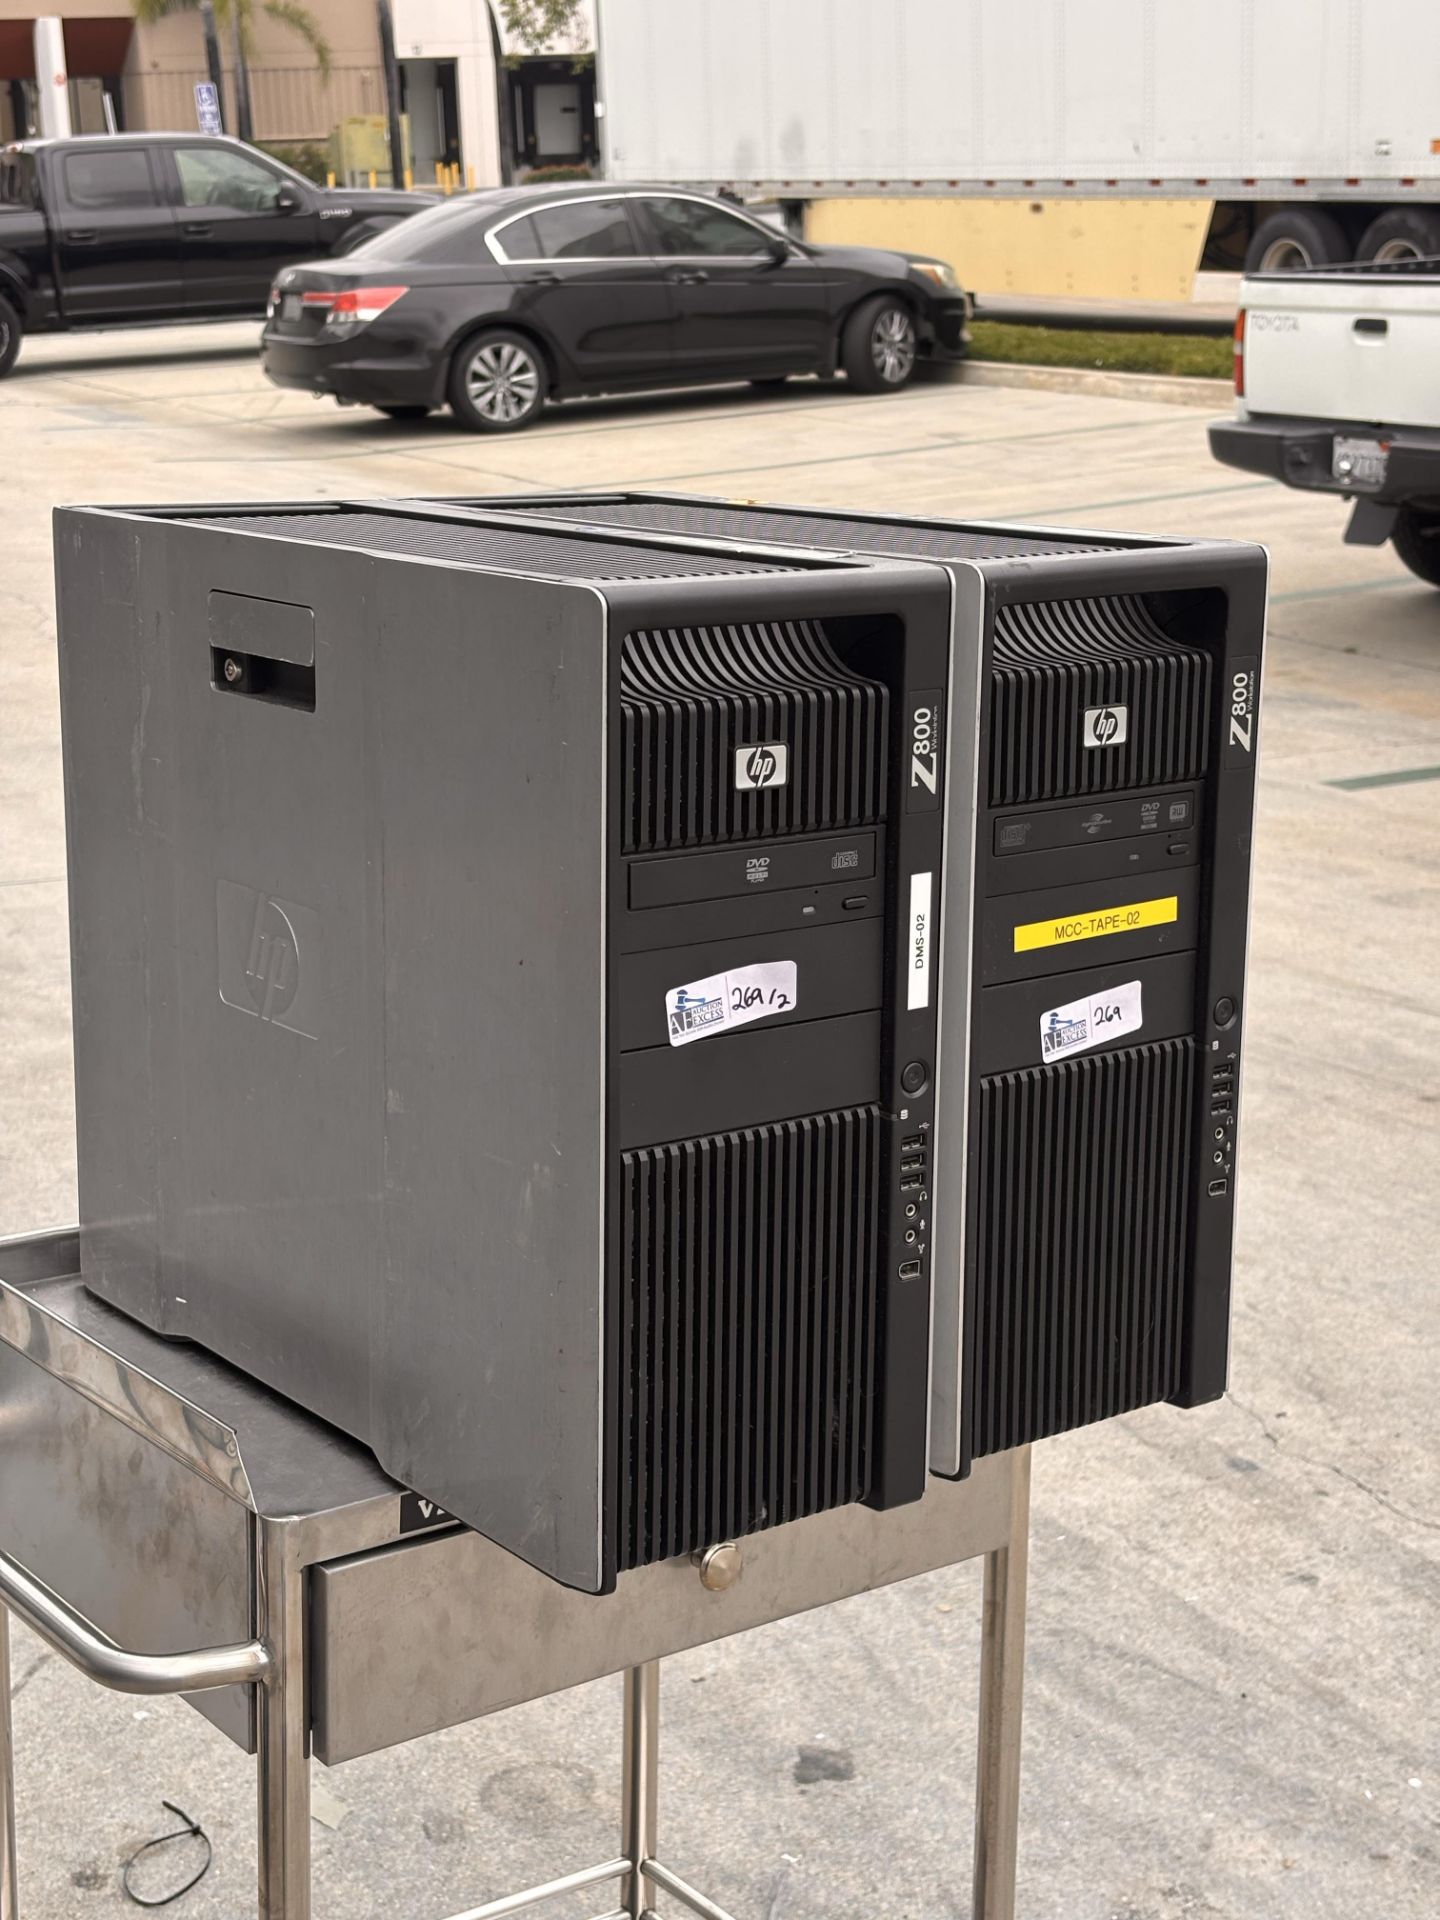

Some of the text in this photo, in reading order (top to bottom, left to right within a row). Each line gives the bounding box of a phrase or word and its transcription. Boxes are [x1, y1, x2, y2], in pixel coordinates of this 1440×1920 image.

[1229, 672, 1252, 752] Z800
[1095, 708, 1116, 745] hp
[911, 707, 937, 794] Z800
[750, 747, 774, 788] hp
[1141, 802, 1160, 812] DVD
[746, 858, 771, 869] DVD
[1054, 910, 1140, 940] MCC-TAPE-02
[914, 913, 925, 970] DMS-02
[692, 1000, 723, 1016] AUCTION
[692, 1008, 724, 1027] EXCESS
[1093, 1004, 1122, 1026] 269
[1061, 1029, 1088, 1045] EXCESS
